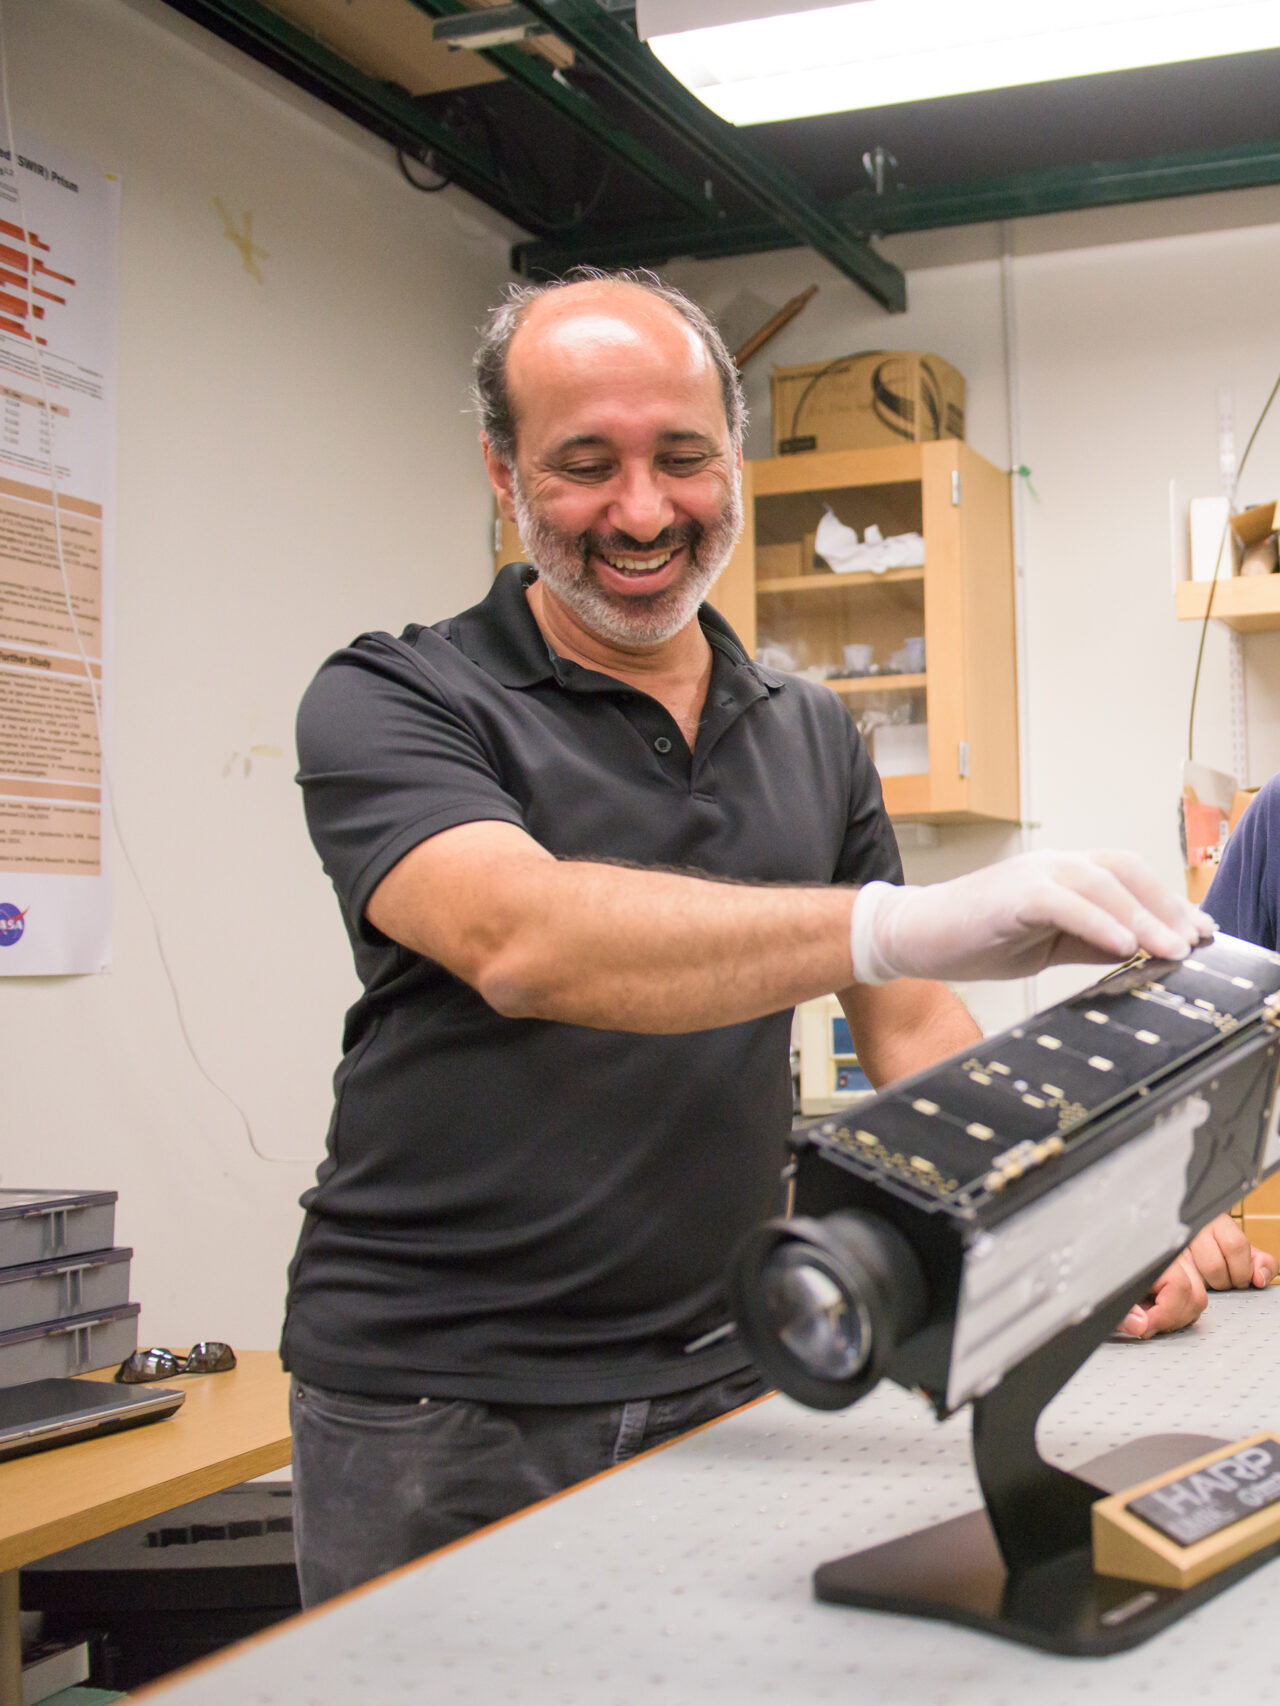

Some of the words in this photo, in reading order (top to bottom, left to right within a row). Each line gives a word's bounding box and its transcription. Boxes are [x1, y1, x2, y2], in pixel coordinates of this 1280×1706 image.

[15, 153, 49, 181] SWIR)
[29, 656, 51, 670] Study
[0, 919, 24, 930] ASA
[1151, 1446, 1273, 1514] HARP
